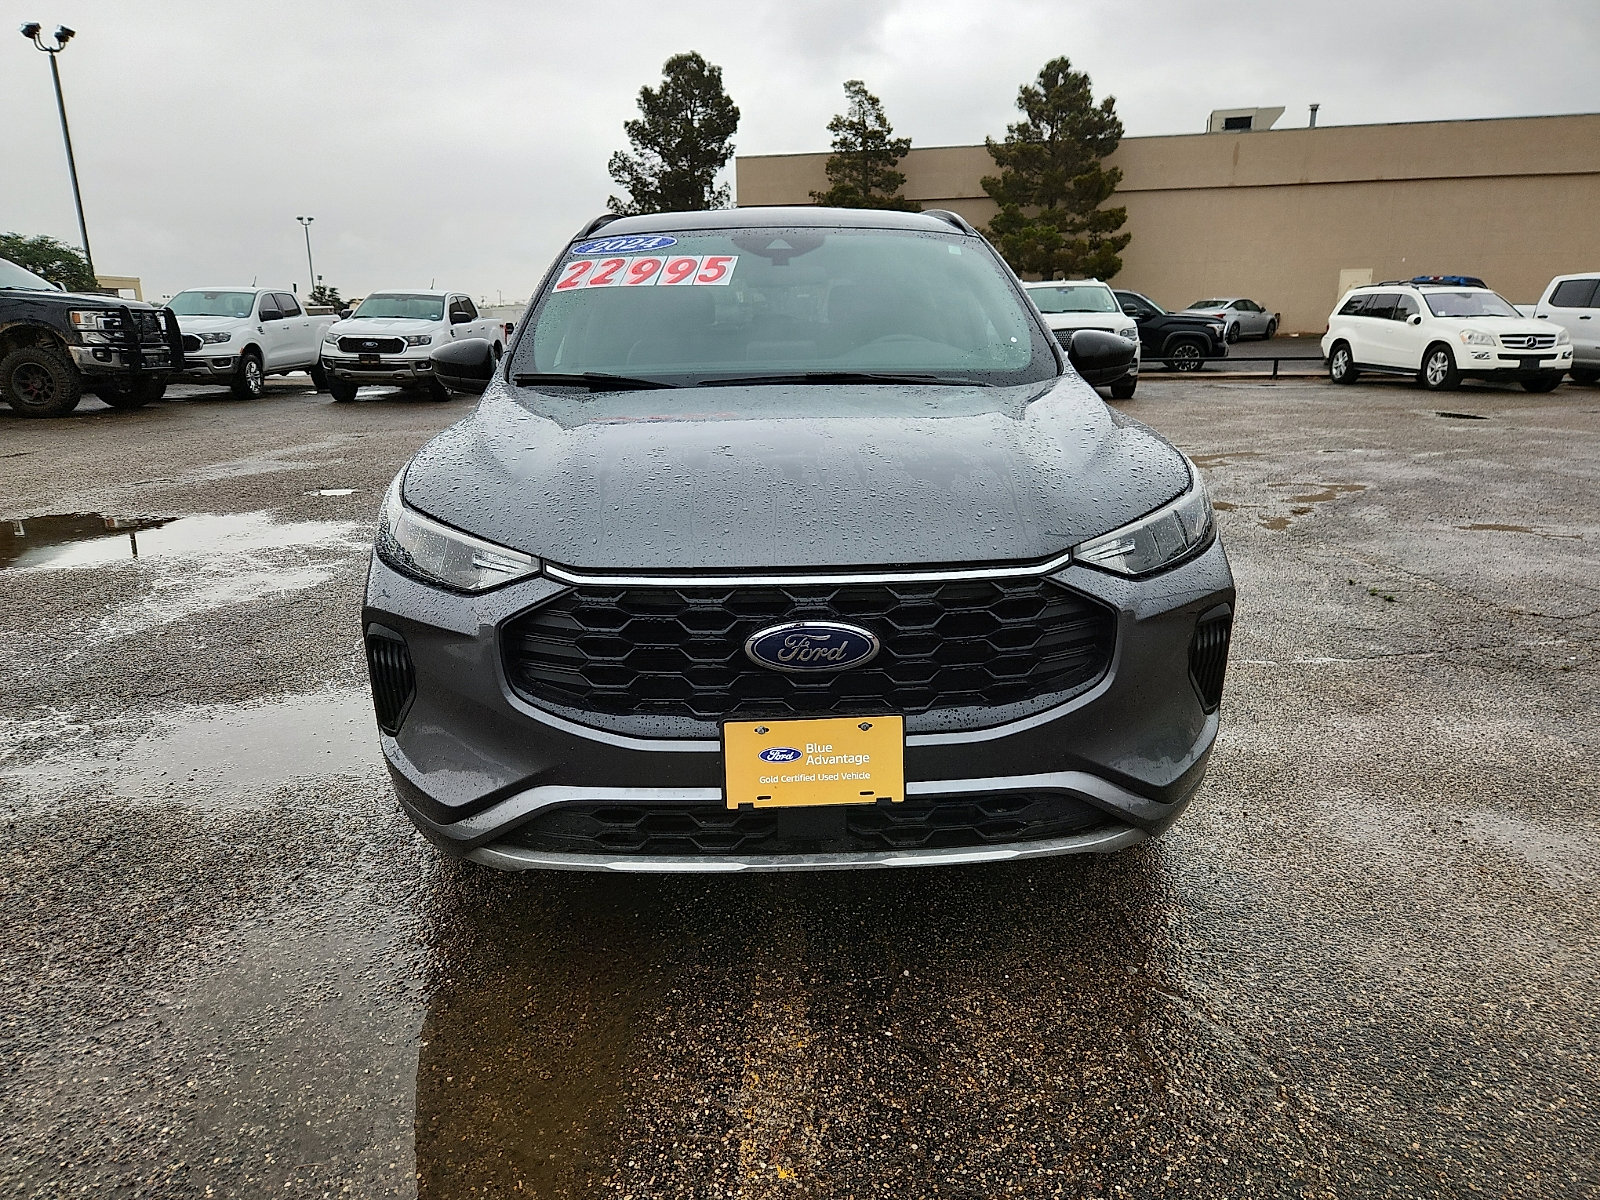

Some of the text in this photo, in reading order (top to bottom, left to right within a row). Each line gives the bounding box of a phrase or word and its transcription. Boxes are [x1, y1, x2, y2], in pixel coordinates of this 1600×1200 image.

[586, 237, 663, 253] 2024
[555, 256, 734, 290] 22995
[777, 633, 849, 662] Ford
[766, 749, 795, 761] Ford
[805, 743, 833, 754] Blue
[805, 754, 870, 765] Advantage
[759, 771, 871, 784] Gold Certified Used Vehicle
